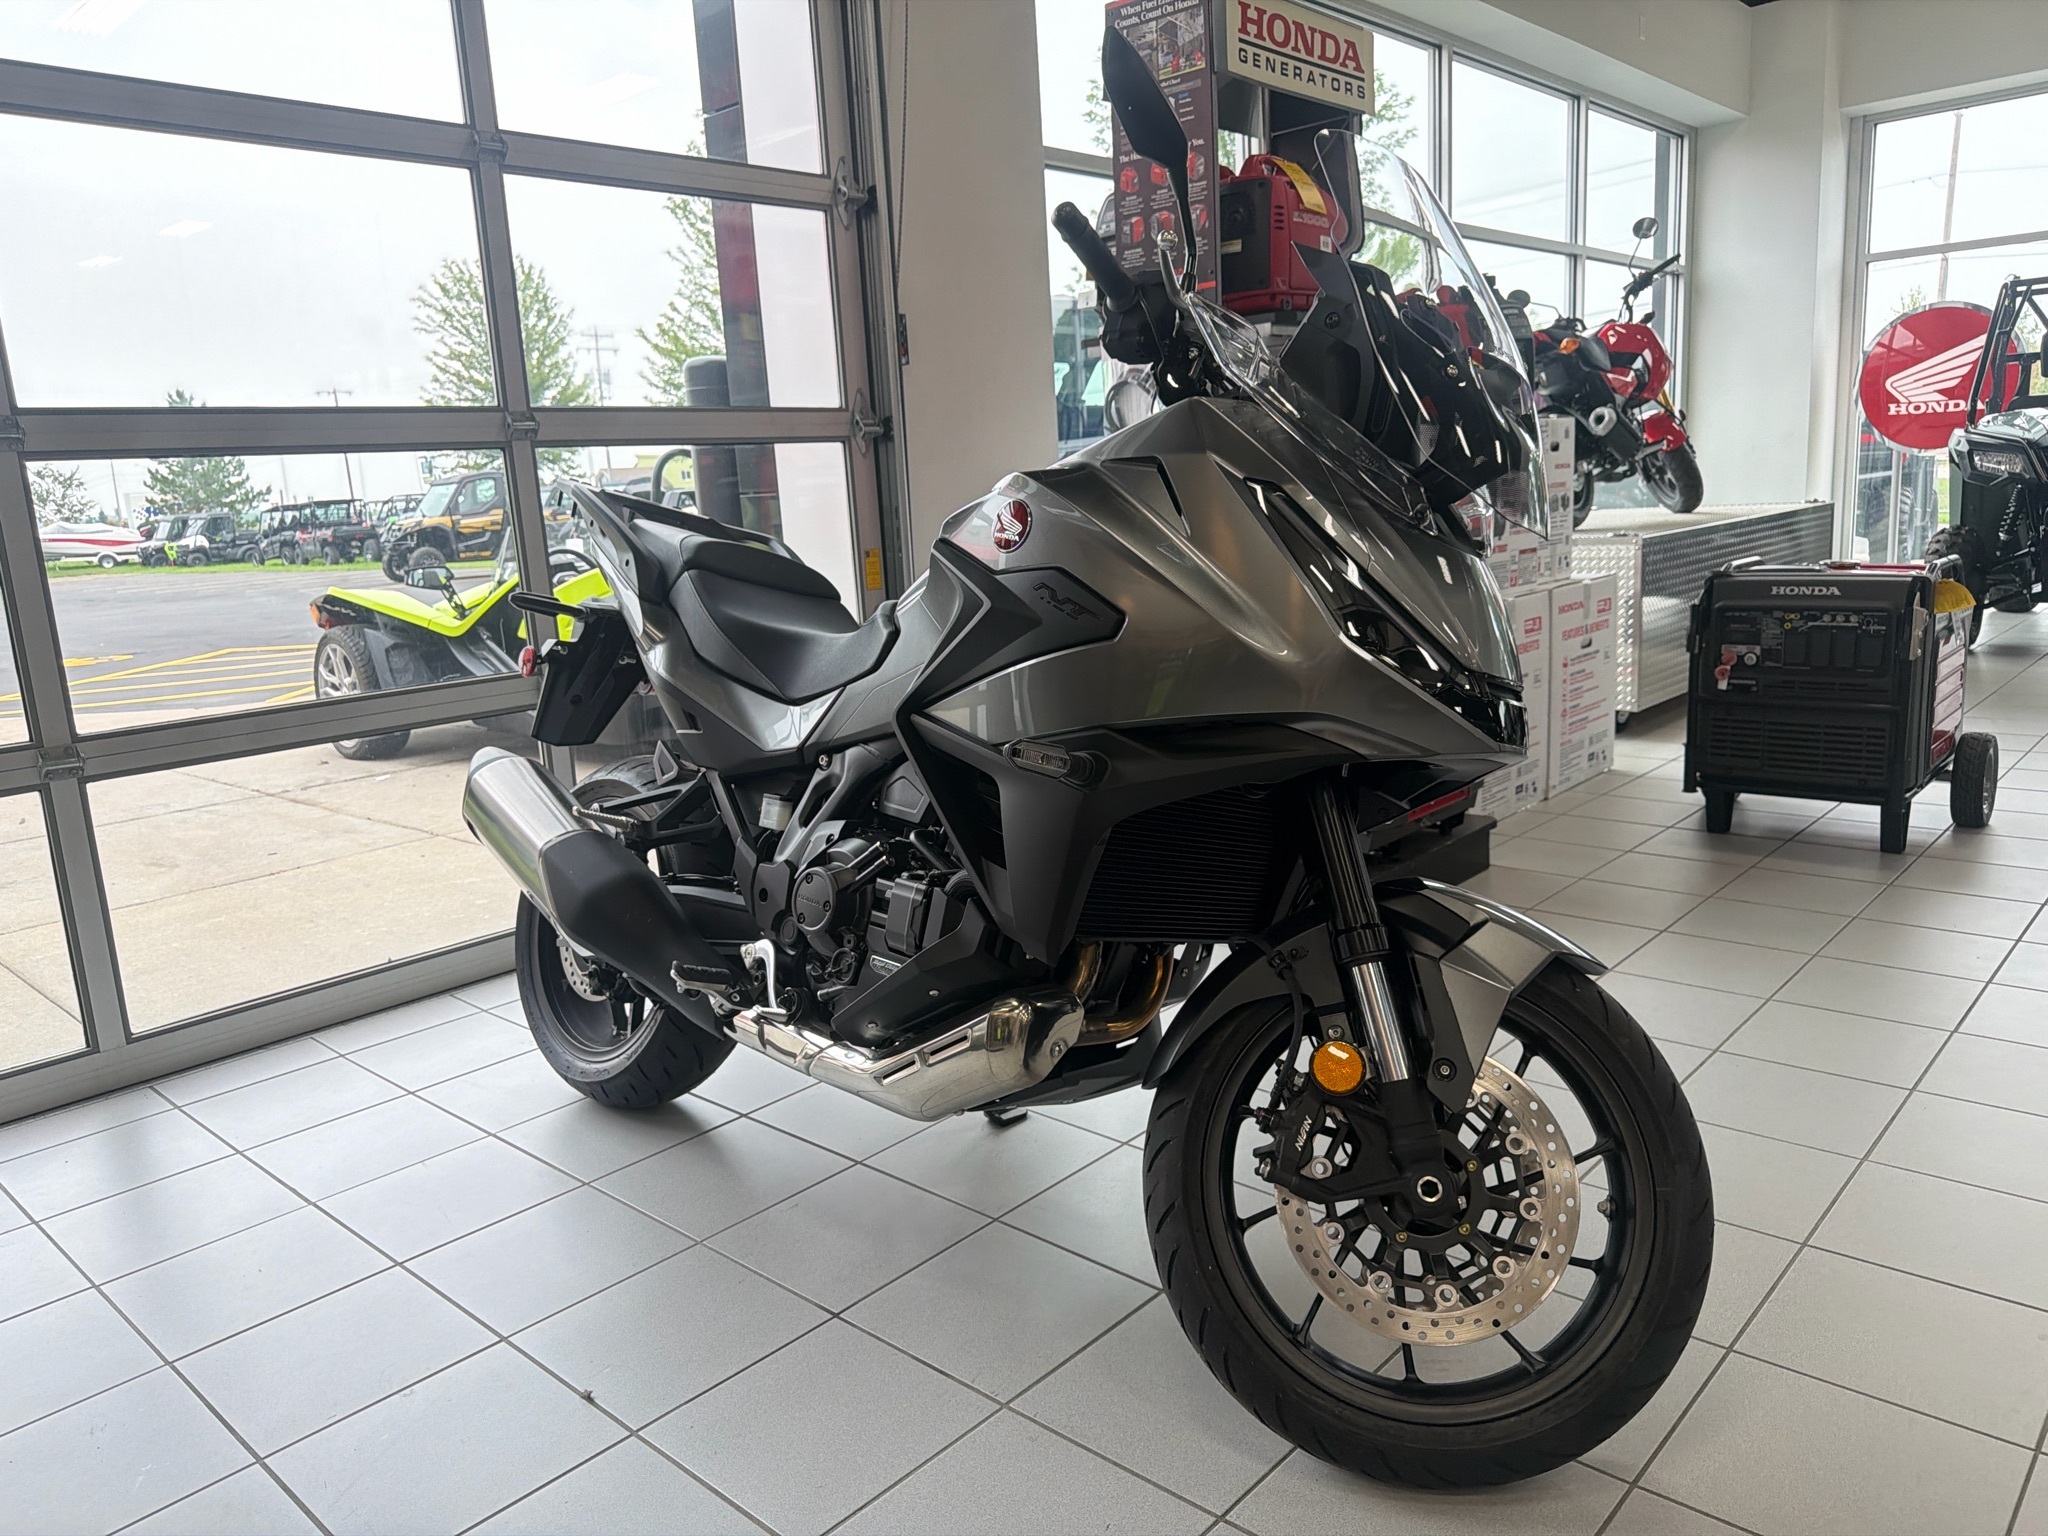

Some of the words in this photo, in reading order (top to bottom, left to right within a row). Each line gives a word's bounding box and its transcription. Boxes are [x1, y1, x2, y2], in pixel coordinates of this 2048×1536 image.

[1115, 16, 1140, 29] Counts,
[1141, 7, 1162, 21] Count
[1162, 4, 1174, 14] On
[1120, 4, 1141, 16] When
[1142, 0, 1157, 10] Fuel
[1238, 0, 1365, 74] HONDA
[1238, 47, 1366, 99] GENERATORS
[994, 532, 1019, 541] HONDA
[1770, 585, 1841, 596] HONDA
